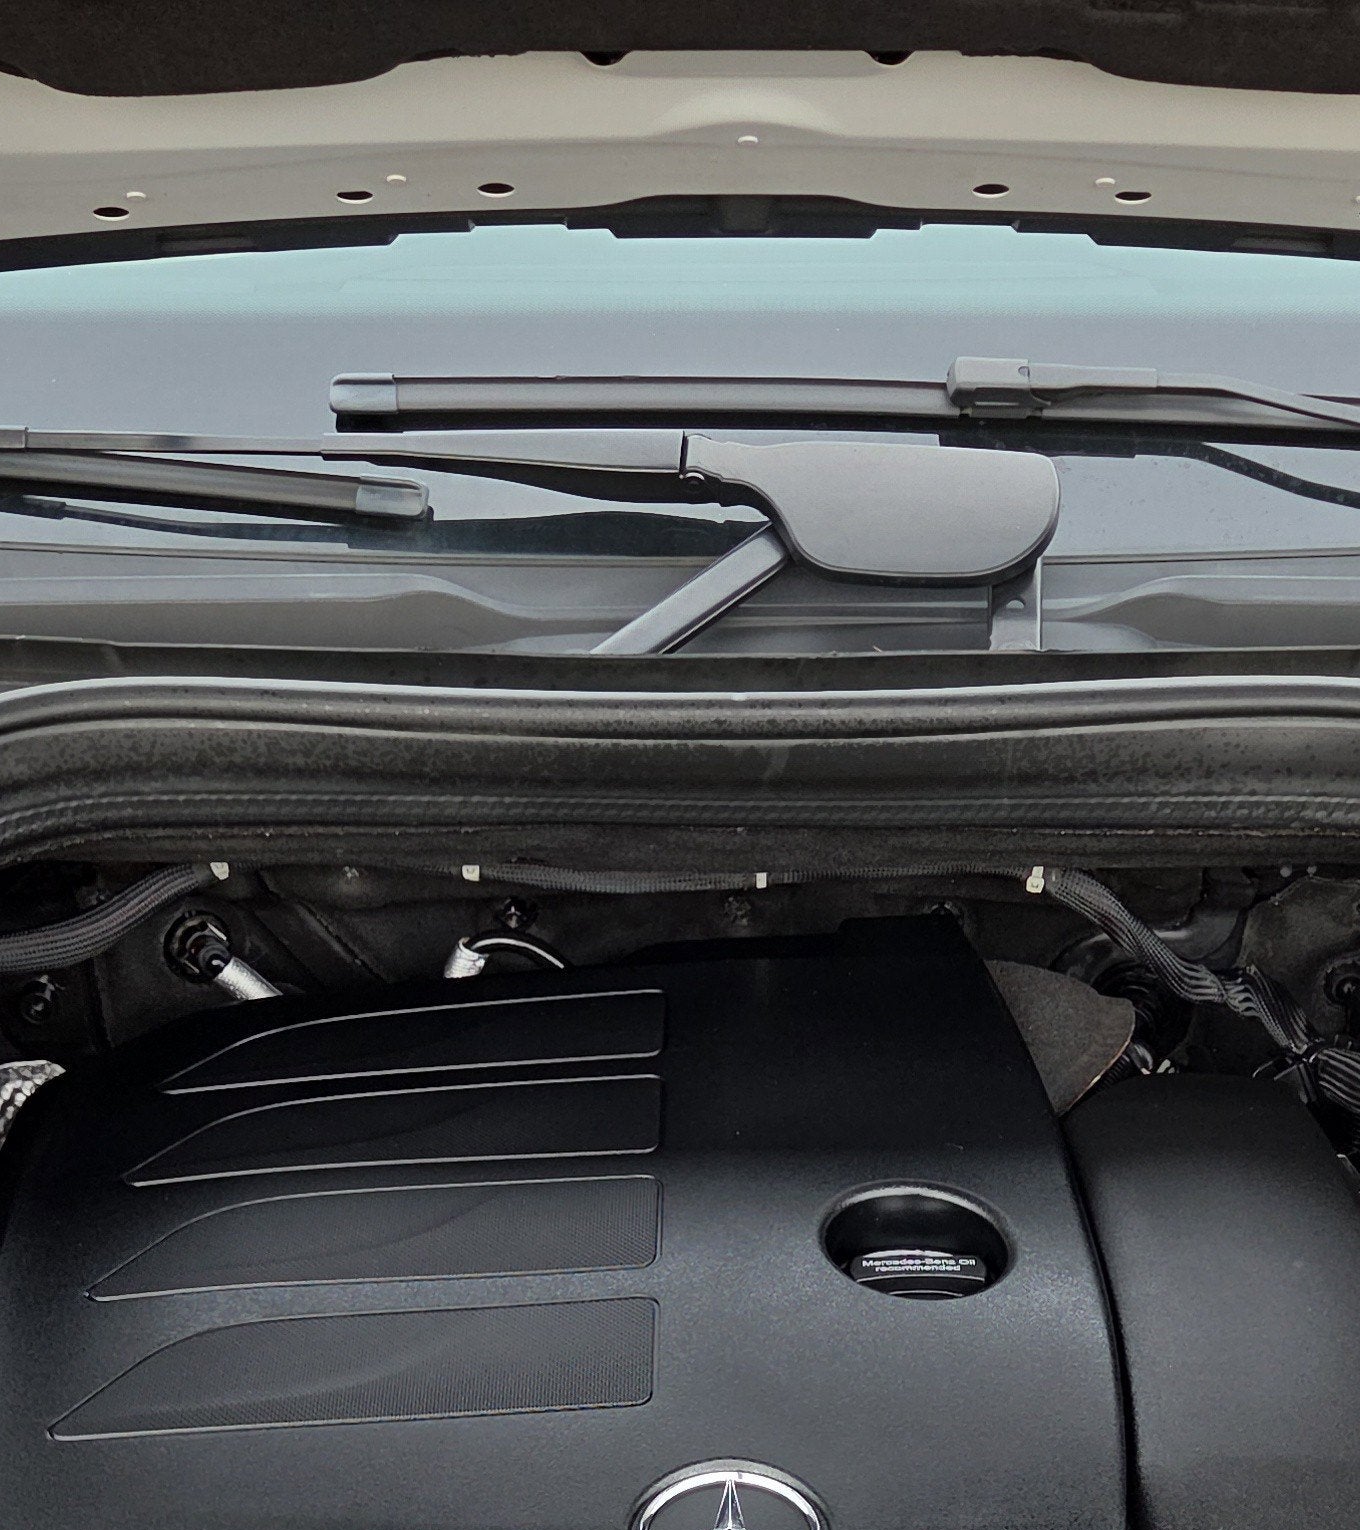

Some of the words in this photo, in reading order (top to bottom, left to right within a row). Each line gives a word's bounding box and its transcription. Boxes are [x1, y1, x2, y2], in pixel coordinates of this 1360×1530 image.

[862, 1258, 956, 1267] Mercedes-Benz
[958, 1258, 976, 1266] Oil
[875, 1264, 961, 1273] recommended
